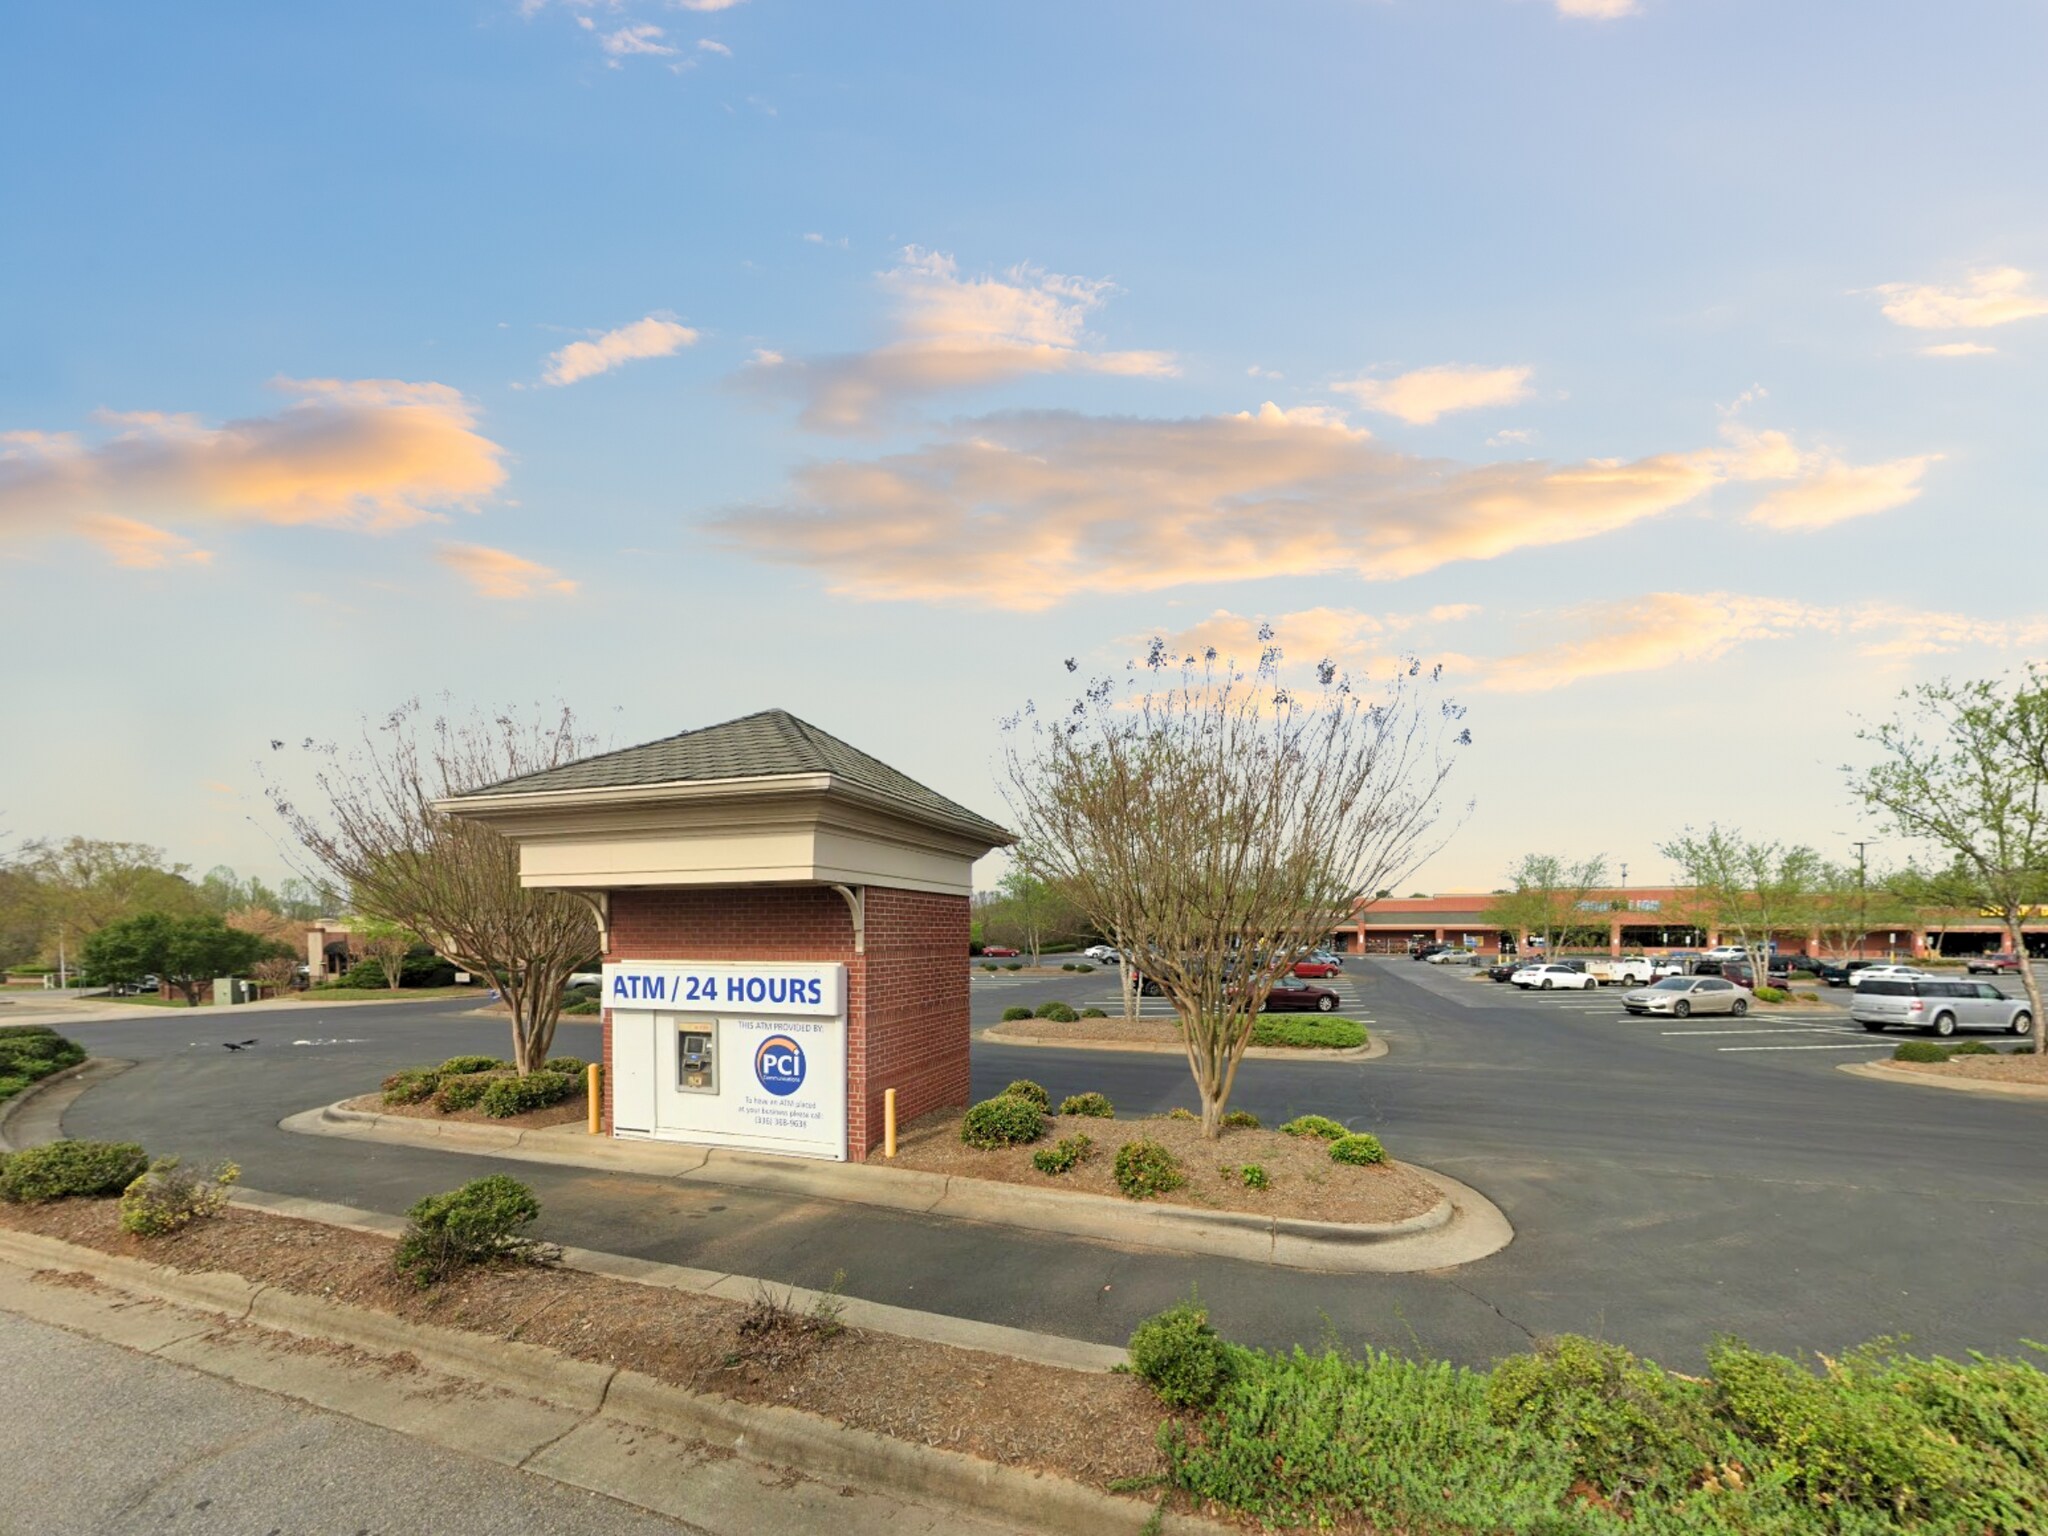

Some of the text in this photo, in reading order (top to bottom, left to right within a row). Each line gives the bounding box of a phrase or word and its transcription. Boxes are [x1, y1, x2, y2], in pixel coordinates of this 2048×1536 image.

[614, 975, 821, 1004] ATM / 24 HOURS
[739, 1021, 754, 1030] THIS
[755, 1022, 773, 1031] ATM
[774, 1023, 811, 1033] PROVIDED
